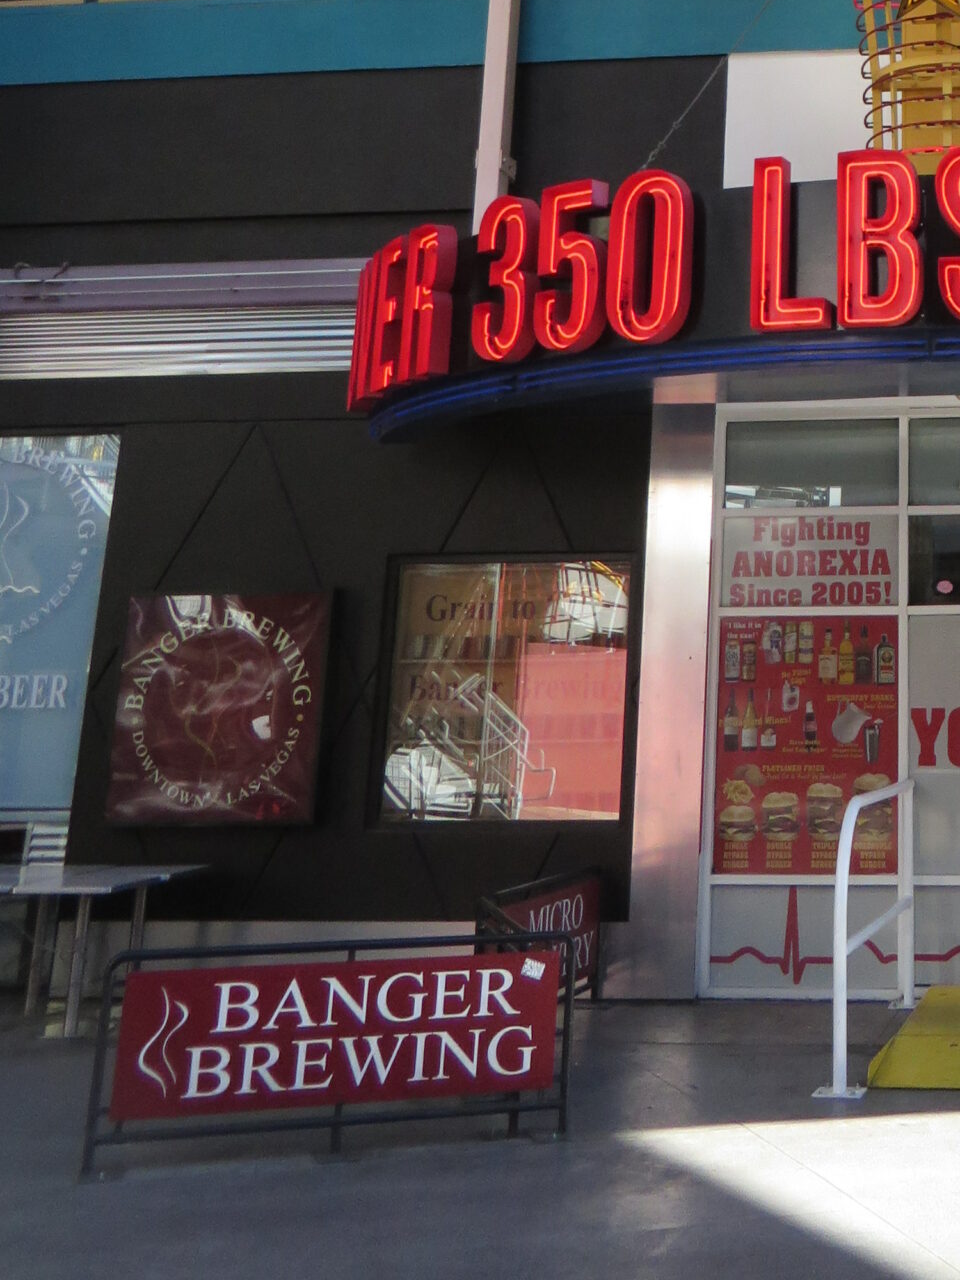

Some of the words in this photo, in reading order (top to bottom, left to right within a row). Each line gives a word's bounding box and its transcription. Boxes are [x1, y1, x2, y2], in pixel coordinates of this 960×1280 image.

[471, 168, 695, 362] 350
[13, 447, 96, 540] BREWING
[732, 549, 891, 578] ANOREXIA
[753, 516, 870, 547] Fighting
[512, 600, 536, 618] to
[729, 582, 802, 607] Since
[811, 581, 892, 606] 2005!
[124, 612, 213, 711] BANGER
[223, 608, 312, 707] BREWING
[132, 731, 208, 807] DOWNTOWN
[227, 782, 261, 805] LAS
[260, 727, 299, 783] VEGAS
[530, 894, 584, 933] MICRO
[210, 968, 522, 1035] BANGER
[180, 1025, 537, 1099] BREWING
